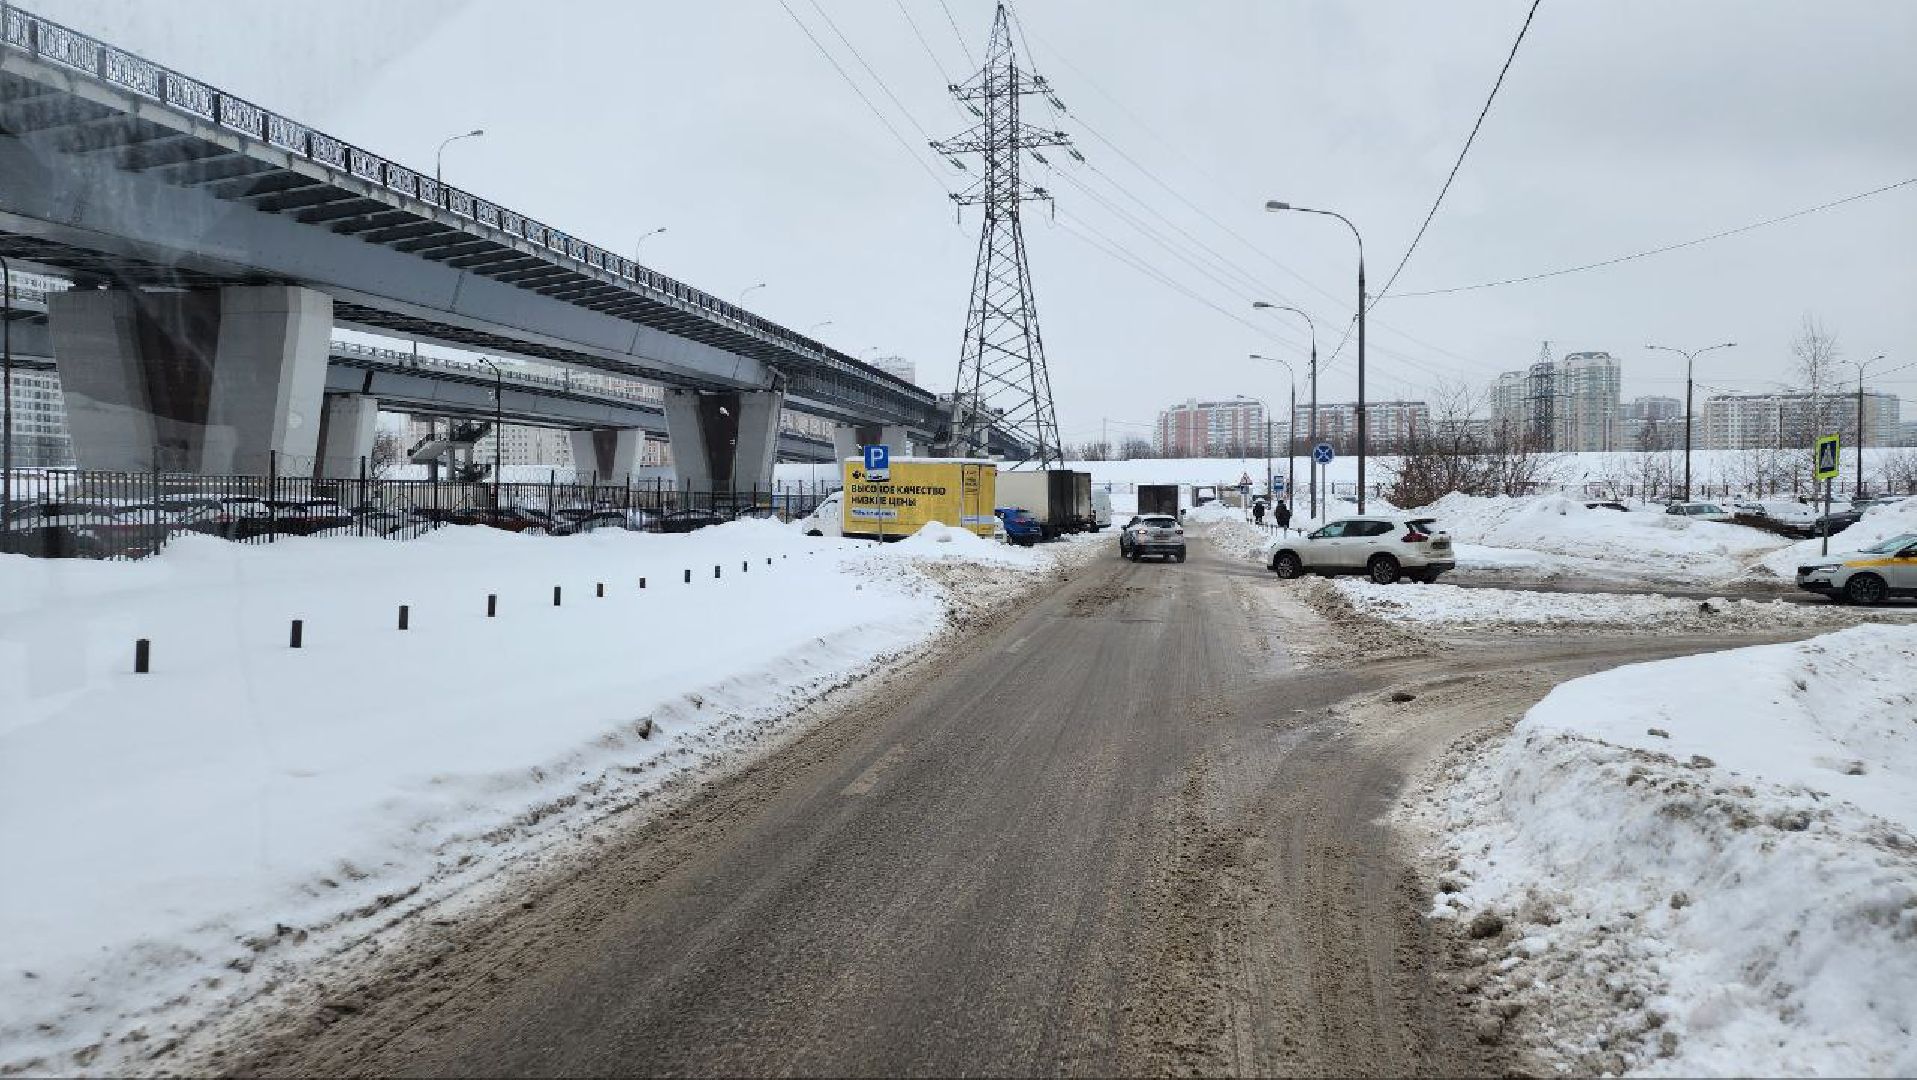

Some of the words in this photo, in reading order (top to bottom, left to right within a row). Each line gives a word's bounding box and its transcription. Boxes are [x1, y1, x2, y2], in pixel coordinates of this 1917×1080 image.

[870, 448, 883, 468] P
[896, 486, 946, 495] КАЧЕСТВО
[888, 497, 916, 507] ЦЕНЫ
